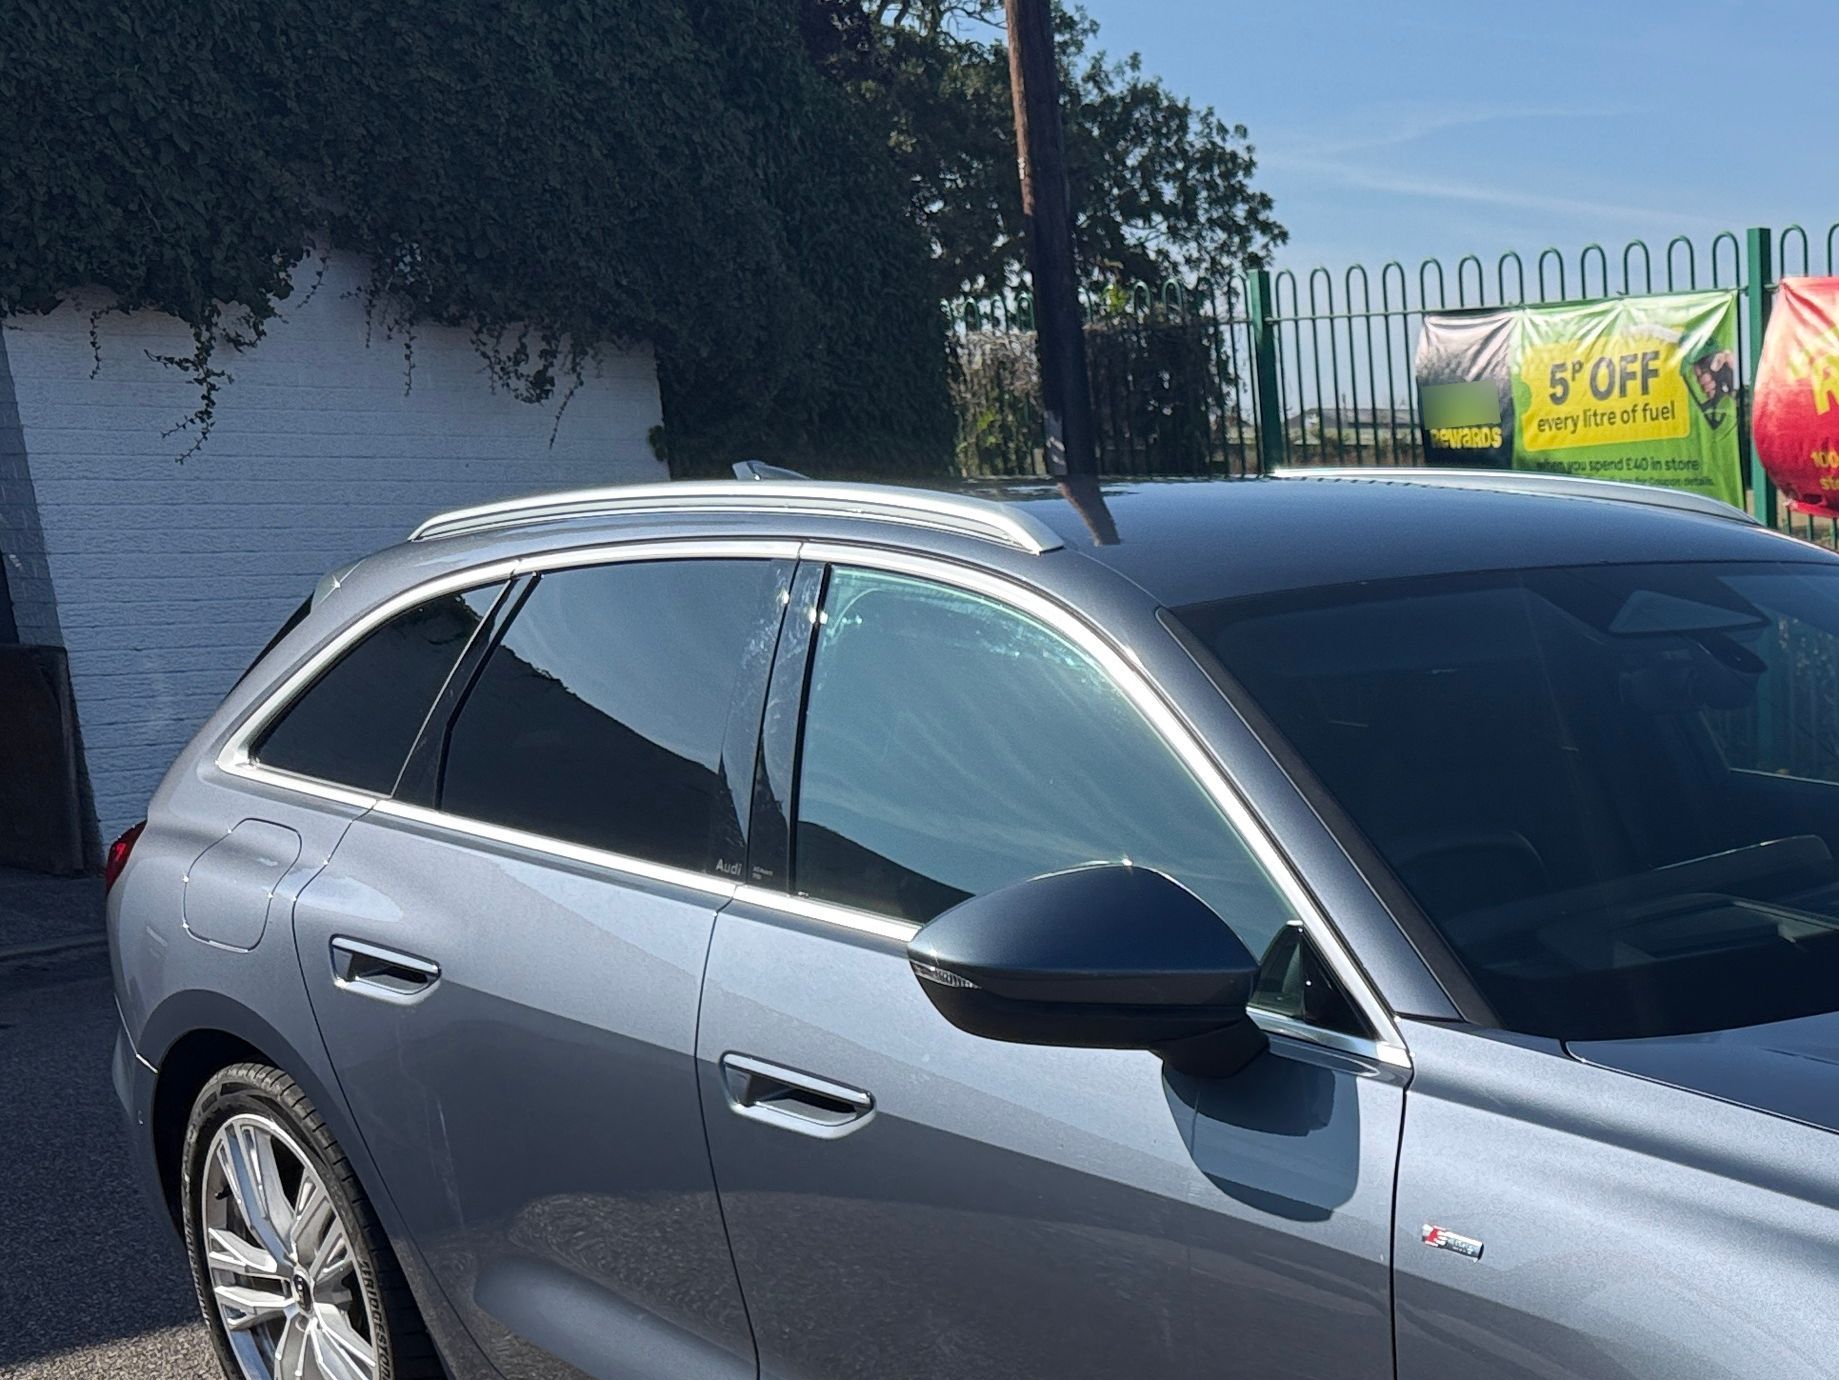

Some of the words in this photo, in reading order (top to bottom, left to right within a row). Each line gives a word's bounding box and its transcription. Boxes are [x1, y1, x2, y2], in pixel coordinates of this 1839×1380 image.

[1590, 350, 1660, 401] OFF
[1537, 413, 1579, 434] every
[1583, 407, 1616, 428] litre
[1620, 403, 1638, 424] of
[1642, 400, 1676, 423] fuel
[1564, 460, 1587, 474] you
[1590, 457, 1623, 473] spend
[1650, 456, 1663, 471] in
[715, 858, 742, 876] Audi
